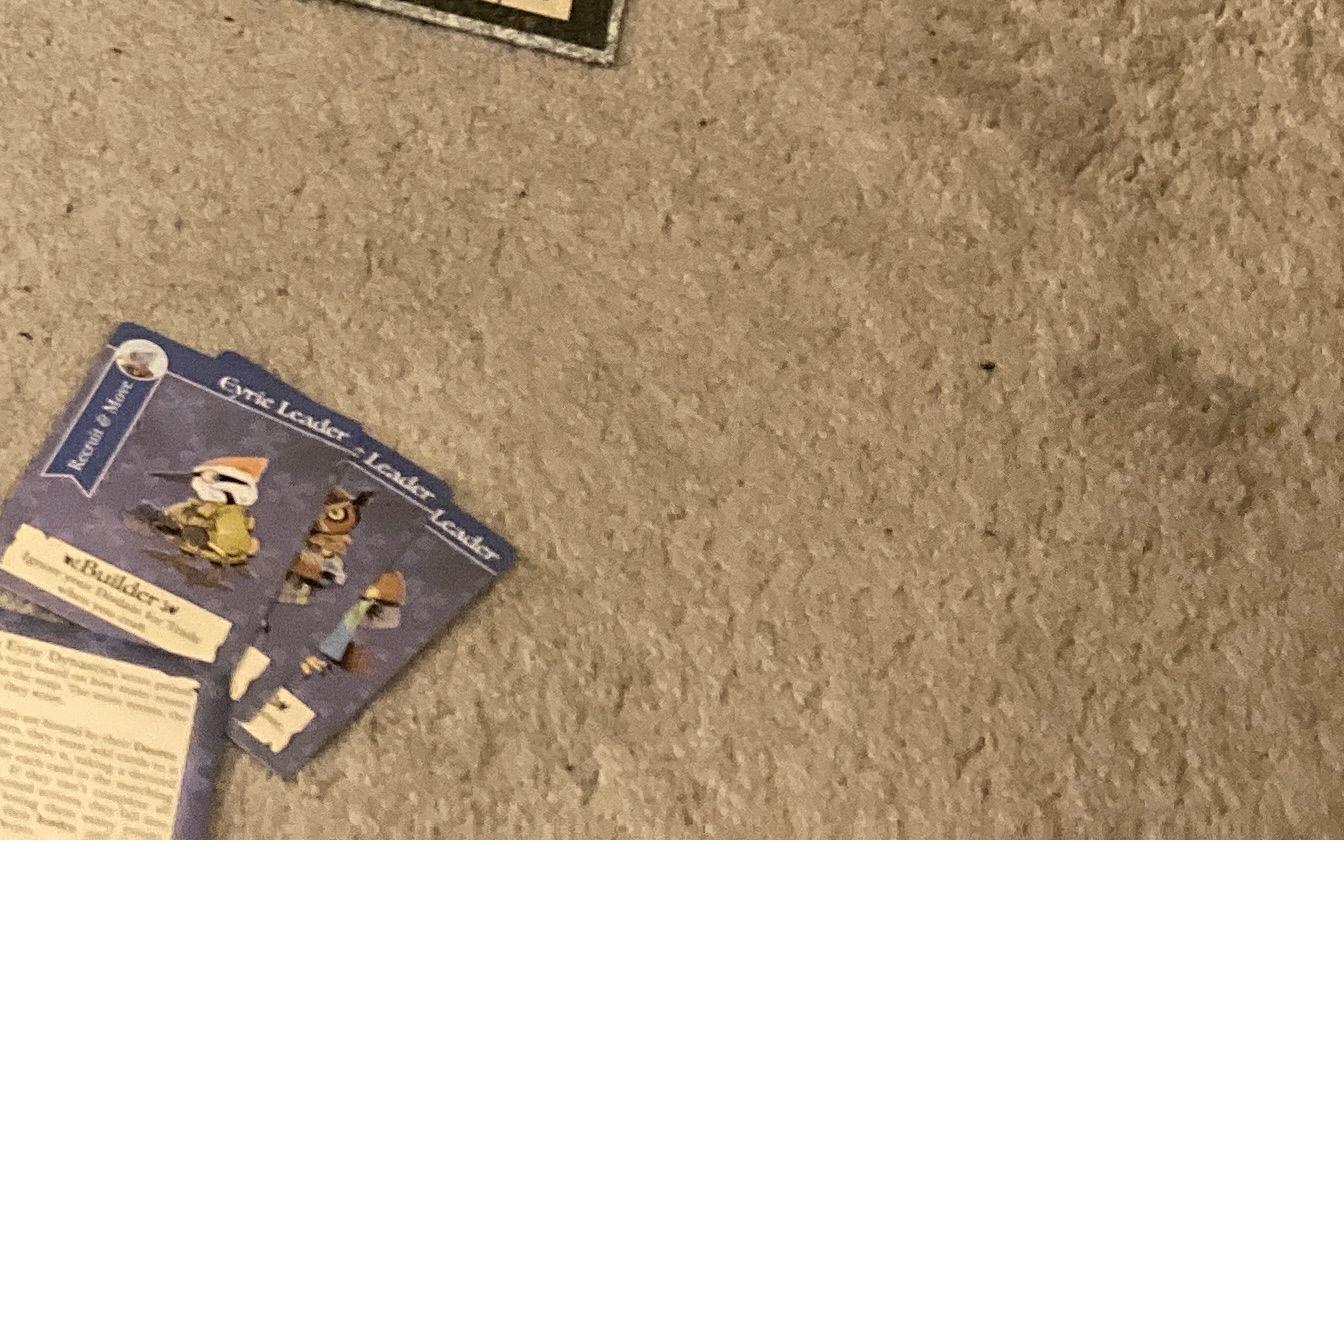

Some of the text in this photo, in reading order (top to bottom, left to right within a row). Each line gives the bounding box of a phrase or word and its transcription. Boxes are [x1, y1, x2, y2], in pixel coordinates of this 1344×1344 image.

[67, 427, 105, 472] Recruit
[102, 380, 135, 416] Move
[219, 376, 352, 442] Eyrie Leader
[364, 452, 437, 501] Leader
[80, 560, 157, 605] Builder
